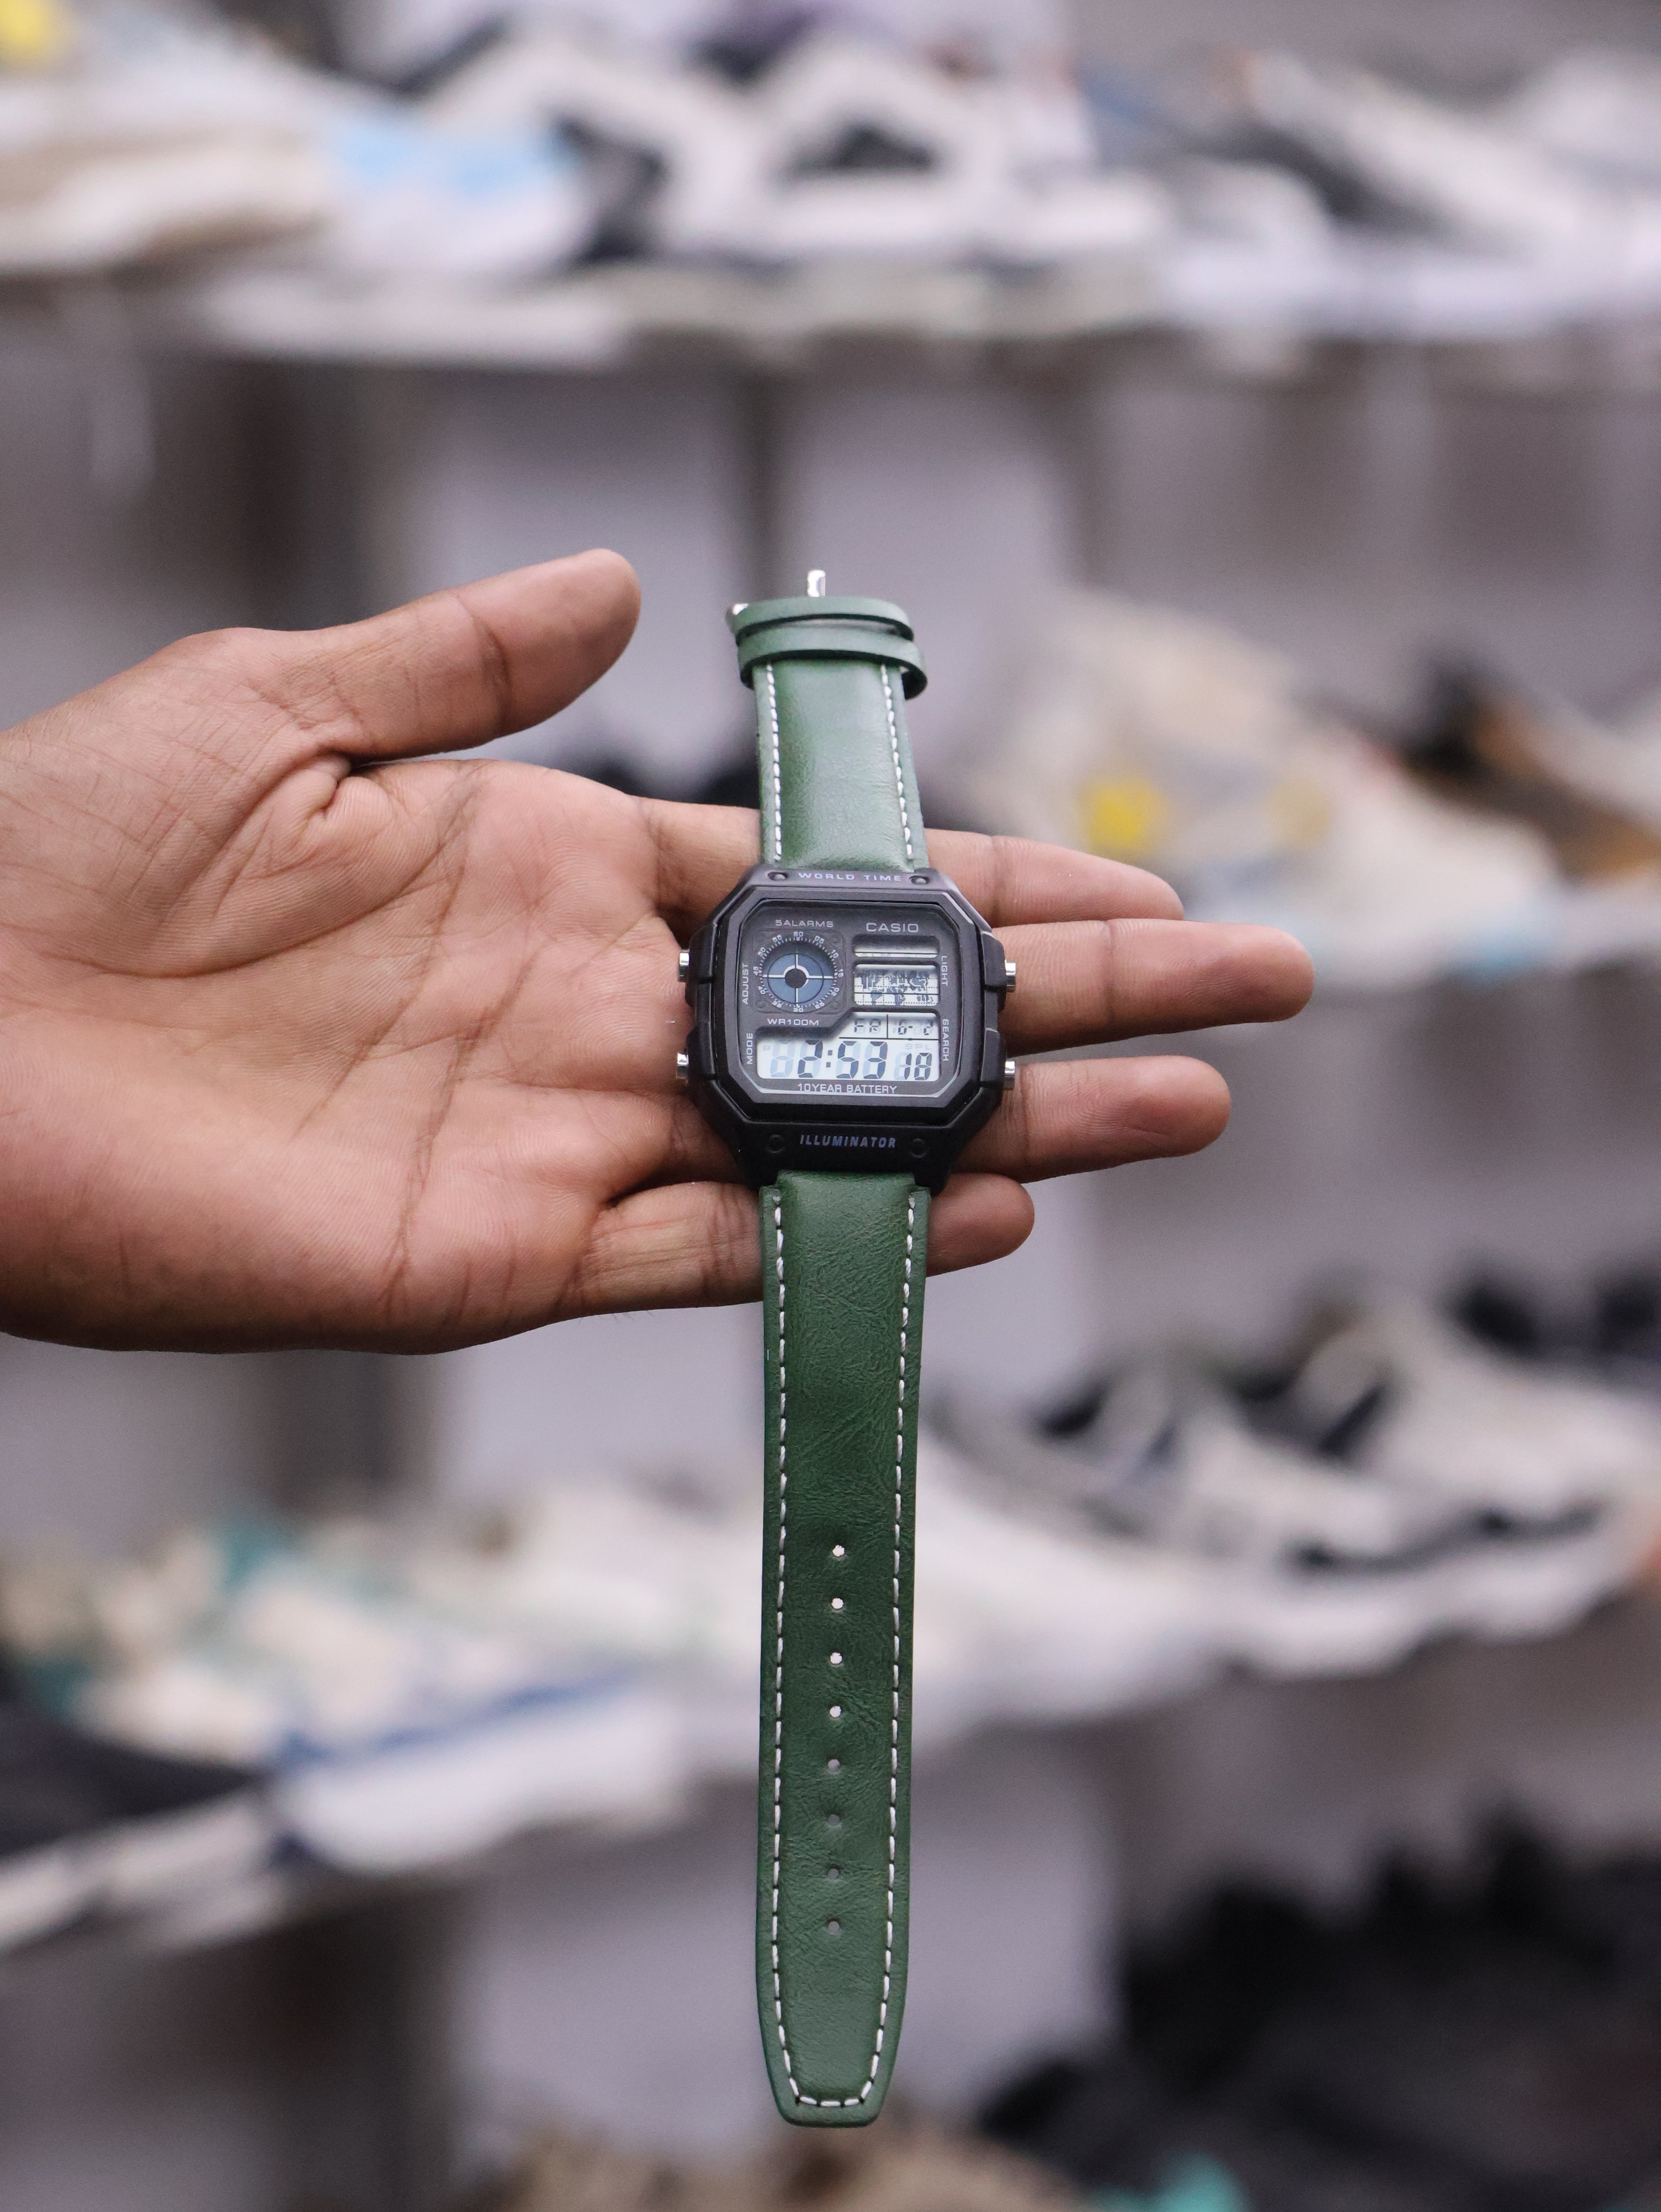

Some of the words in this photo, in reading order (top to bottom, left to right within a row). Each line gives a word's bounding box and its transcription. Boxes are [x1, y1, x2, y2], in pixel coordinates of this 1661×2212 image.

[798, 872, 855, 880] WORLD
[866, 922, 919, 933] CASIO
[814, 935, 825, 944] 05
[831, 949, 839, 958] 10
[831, 987, 840, 996] 20
[798, 1039, 888, 1079] 2:53
[904, 1053, 932, 1080] 18
[847, 1085, 897, 1094] BATTERY
[800, 1135, 896, 1148] ILLUMINATOR
